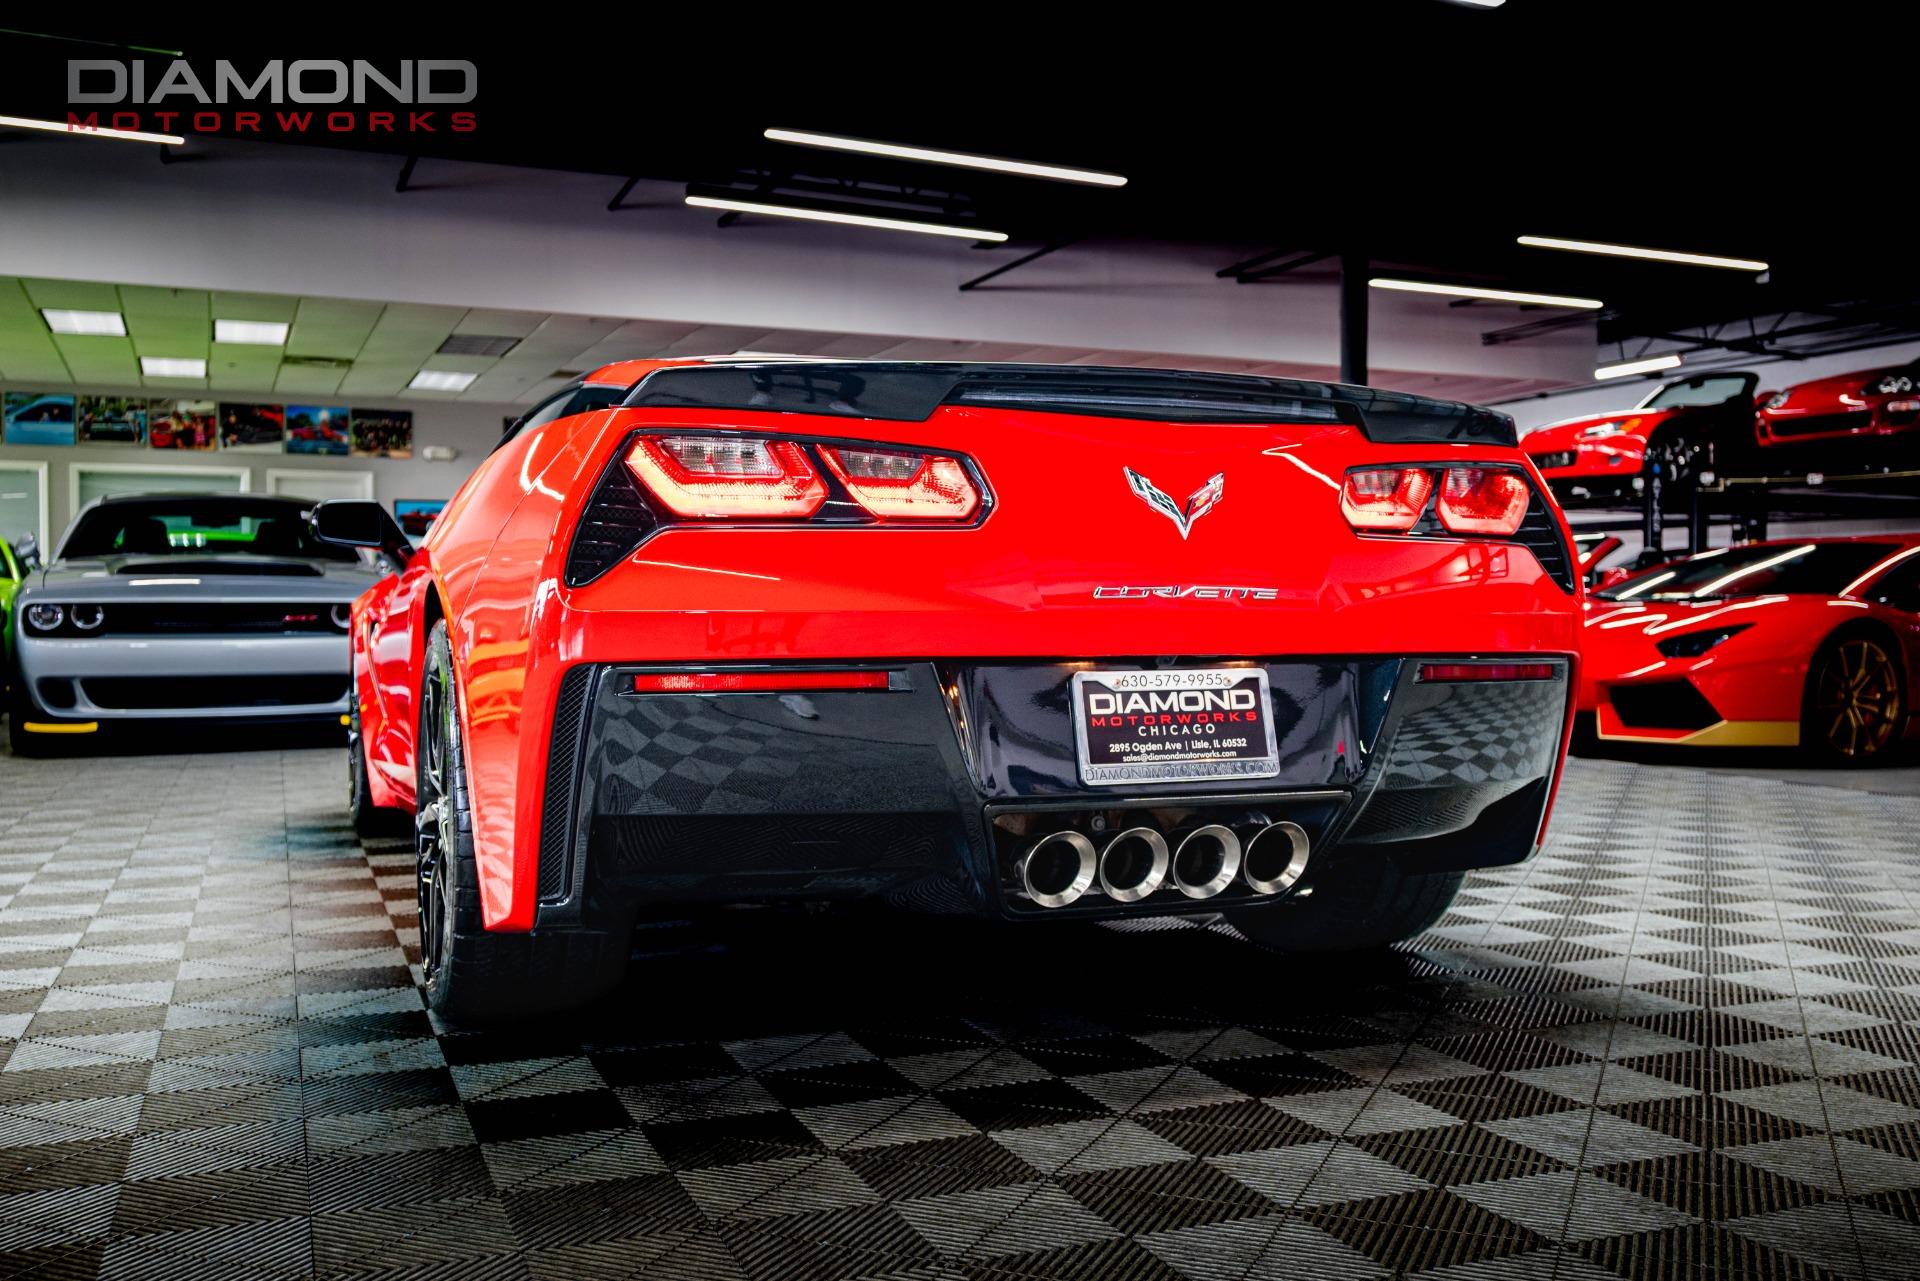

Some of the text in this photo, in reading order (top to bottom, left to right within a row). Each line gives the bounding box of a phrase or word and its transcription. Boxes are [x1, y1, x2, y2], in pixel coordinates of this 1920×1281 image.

[1093, 585, 1279, 600] CORVETTE
[1121, 674, 1223, 688] 630-579-9955
[1089, 689, 1255, 714] DIAMOND
[1092, 711, 1257, 727] MOTORWORKS
[1138, 723, 1215, 736] CHICAGO
[1109, 743, 1130, 753] 2895
[1132, 742, 1162, 754] Ogden
[1164, 742, 1182, 751] Ave
[1191, 740, 1212, 751] Lisle,
[1222, 738, 1247, 748] 60532
[1122, 750, 1237, 763] sales@diamondmotorworks.com
